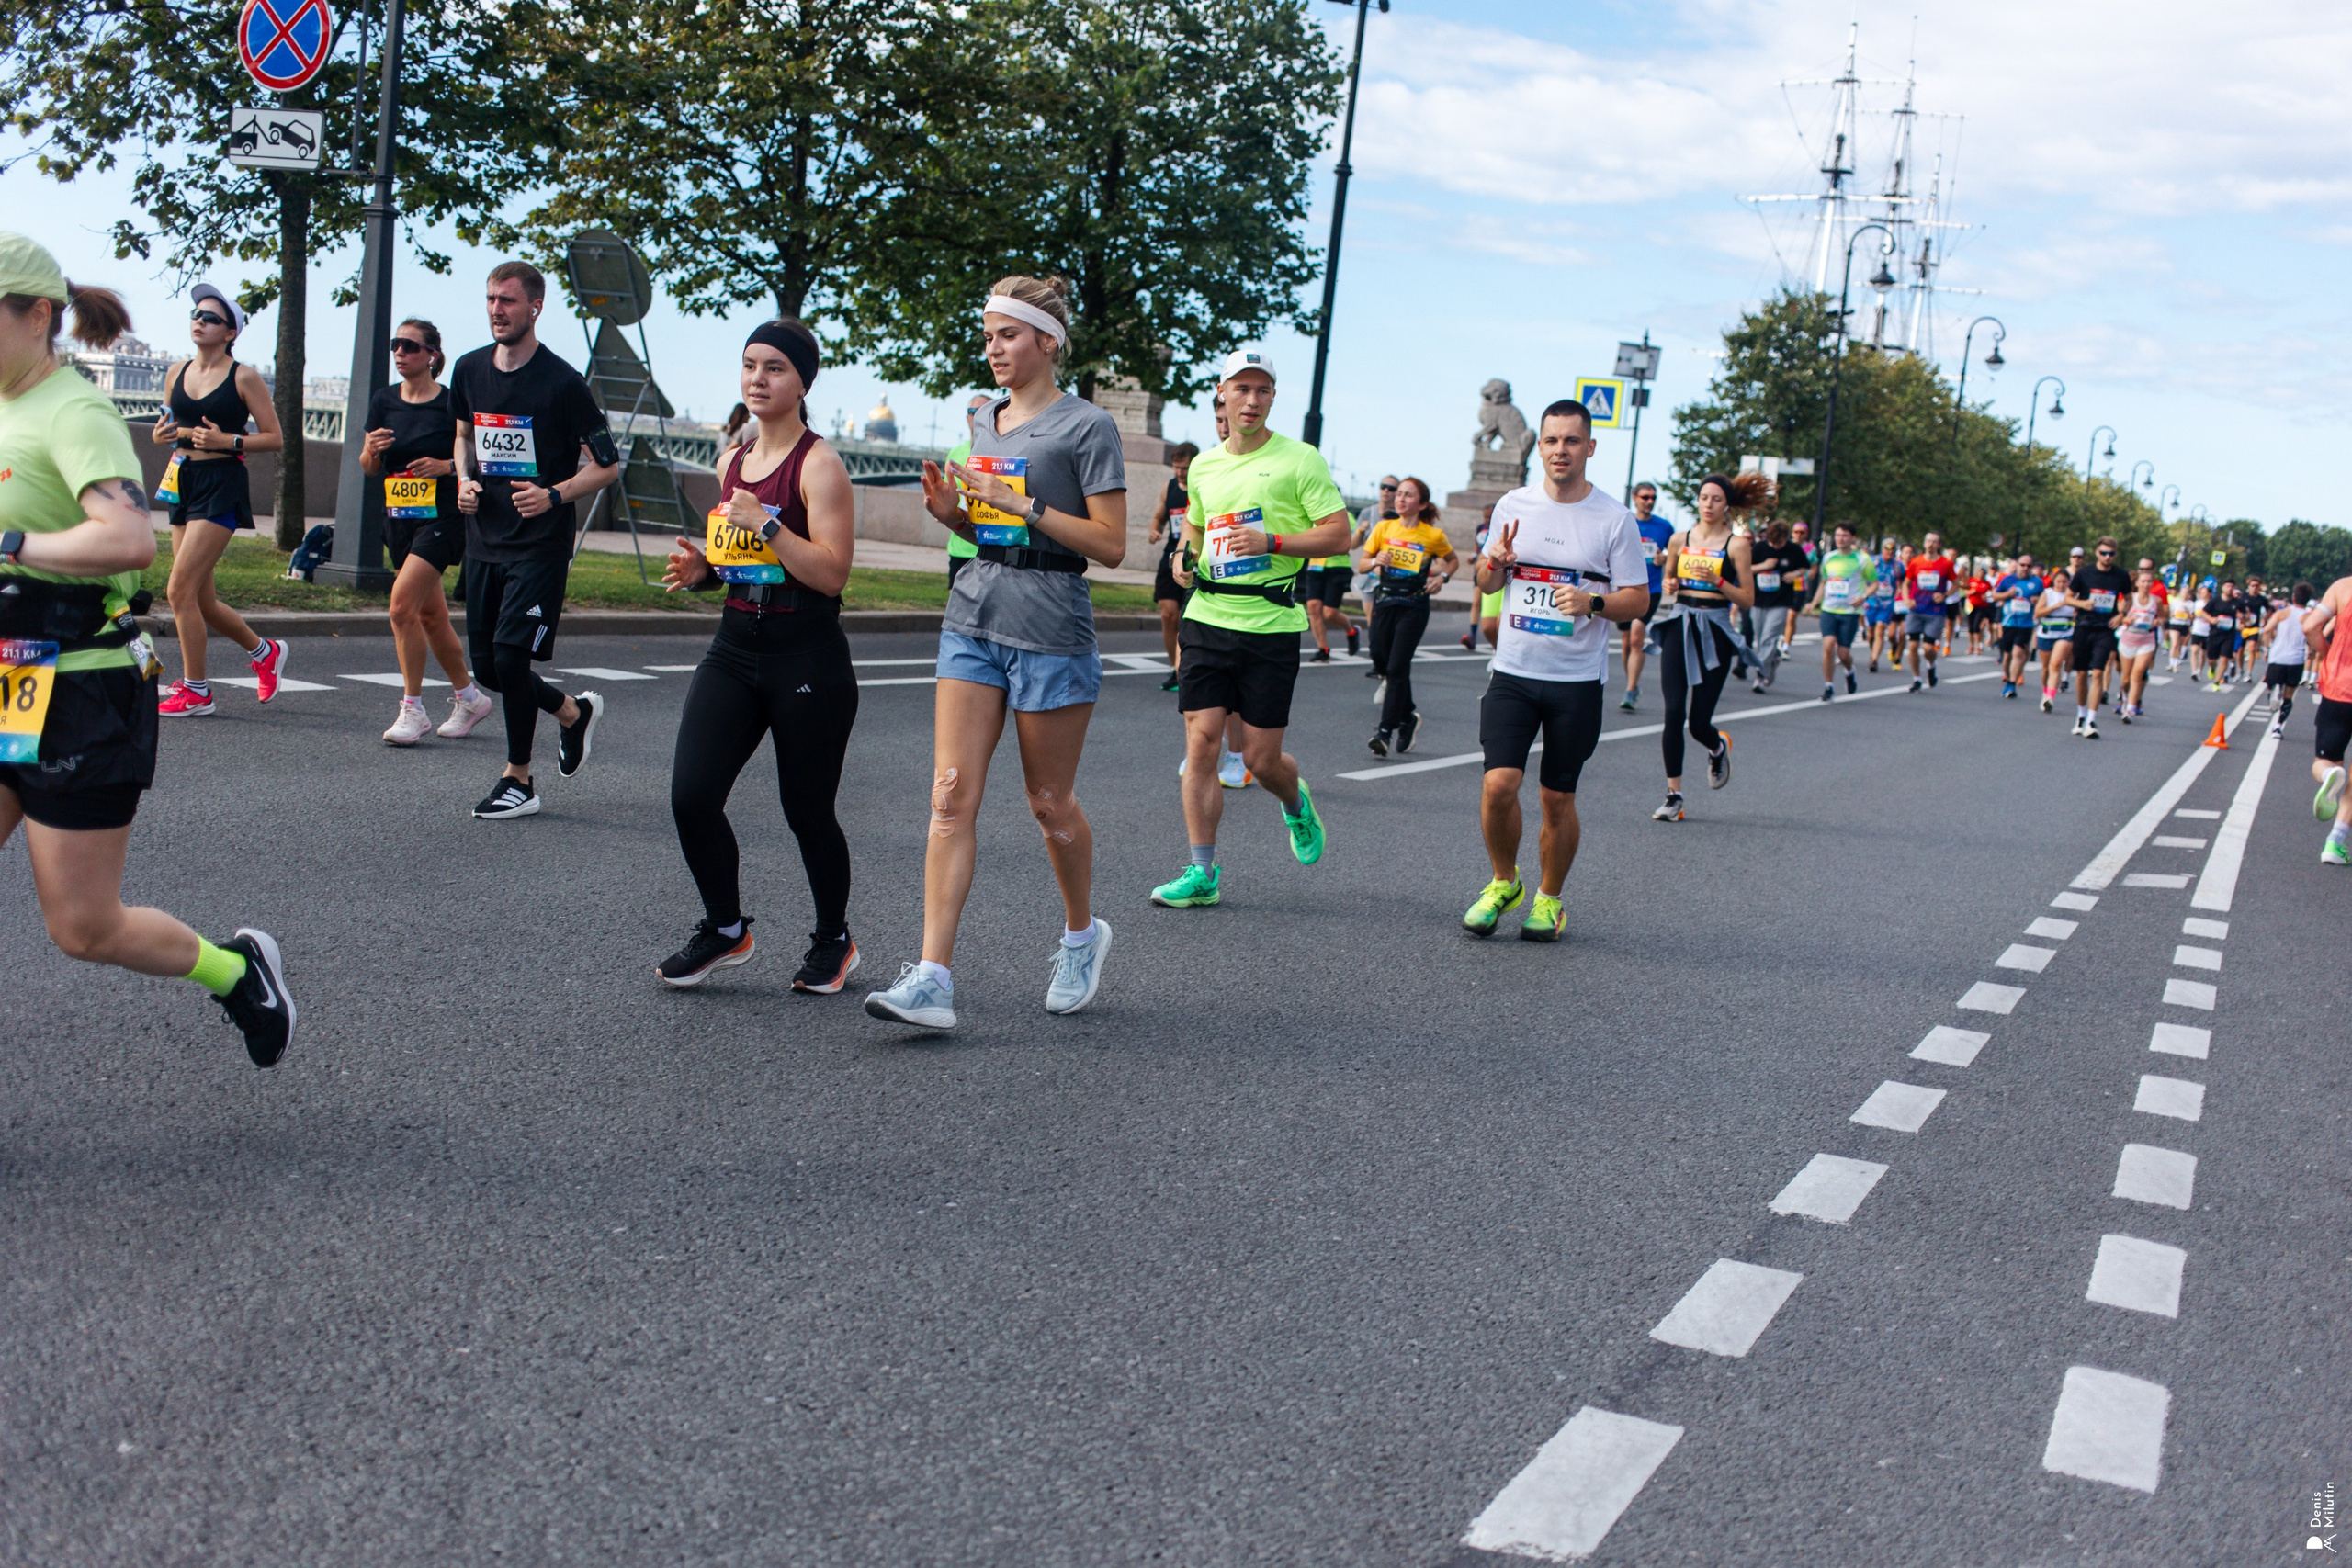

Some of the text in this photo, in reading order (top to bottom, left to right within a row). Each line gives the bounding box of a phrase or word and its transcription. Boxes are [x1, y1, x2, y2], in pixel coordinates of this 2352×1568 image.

[482, 432, 526, 452] 6432
[481, 462, 488, 473] E
[991, 462, 1003, 471] 21,1
[391, 481, 429, 498] 4809
[391, 507, 399, 517] E
[976, 511, 1000, 520] СОФЬЯ
[724, 553, 754, 561] УЛЬЯНА
[1387, 547, 1417, 564] 5553
[1216, 566, 1223, 577] E
[1529, 607, 1551, 615] ИГОРЬ
[1513, 616, 1521, 627] E
